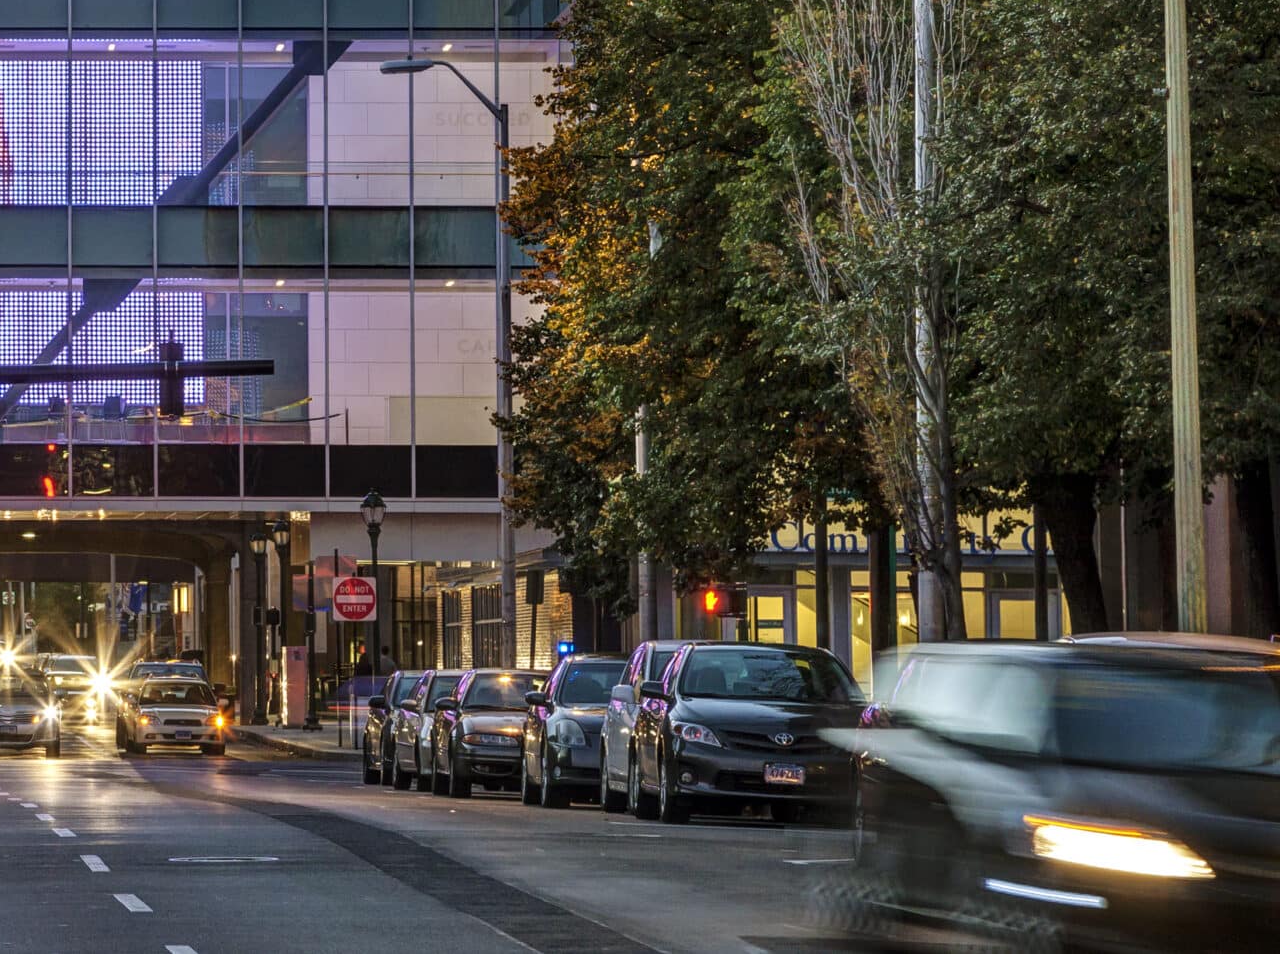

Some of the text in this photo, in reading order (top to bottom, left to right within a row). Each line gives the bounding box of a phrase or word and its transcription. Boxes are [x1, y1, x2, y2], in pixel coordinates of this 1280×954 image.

[435, 111, 530, 127] SUCCED
[339, 586, 370, 594] DO NOT
[342, 605, 367, 613] ENTER
